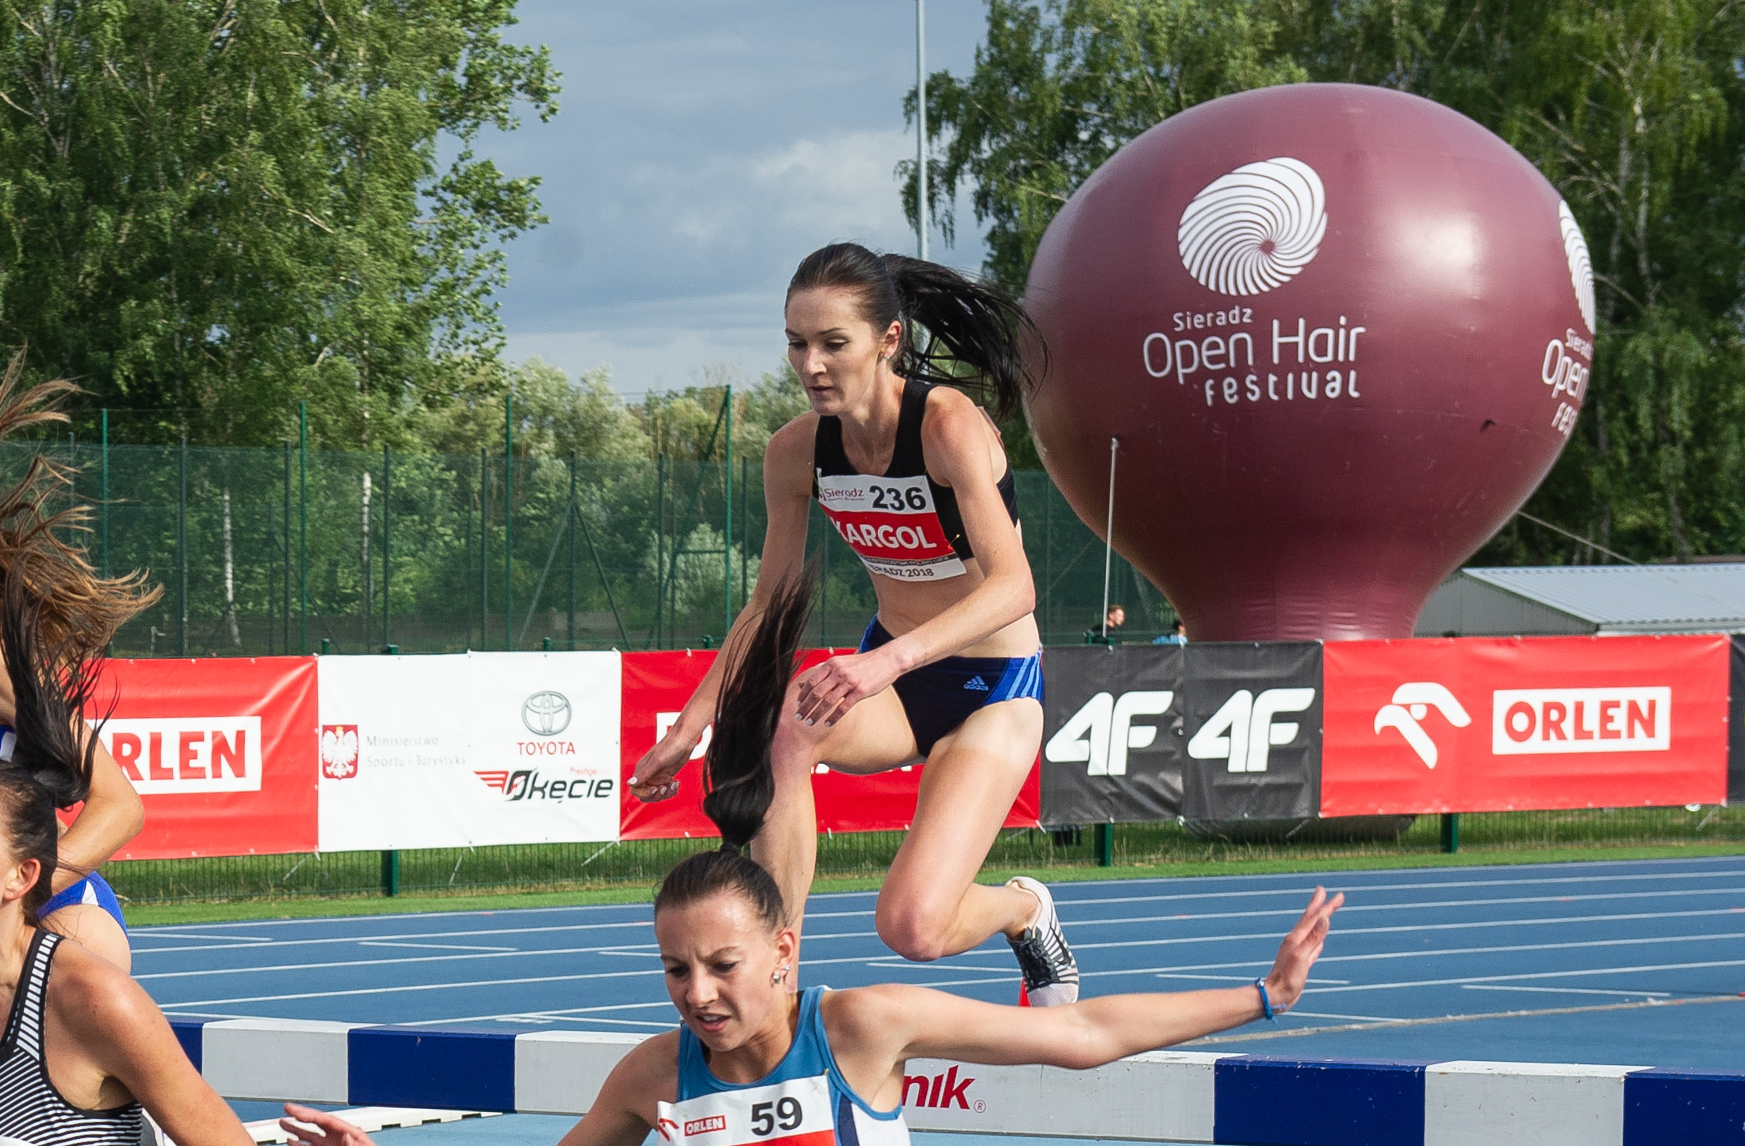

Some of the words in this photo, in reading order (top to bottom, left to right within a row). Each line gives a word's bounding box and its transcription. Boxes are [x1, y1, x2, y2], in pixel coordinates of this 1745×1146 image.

[1173, 305, 1253, 332] Sieradz
[1143, 332, 1254, 385] Open
[1272, 315, 1367, 365] Hair
[1542, 339, 1589, 402] Open
[824, 487, 865, 498] Sieradz
[869, 485, 926, 511] 236
[905, 568, 935, 578] 2018
[366, 735, 439, 747] Ministerstwo
[1045, 690, 1174, 777] 4F
[1187, 687, 1316, 773] 4F
[1503, 699, 1659, 743] ORLEN
[112, 729, 247, 782] RLEN
[517, 741, 576, 756] TOYOTA
[686, 1116, 724, 1135] ORLEN
[751, 1096, 803, 1136] 59
